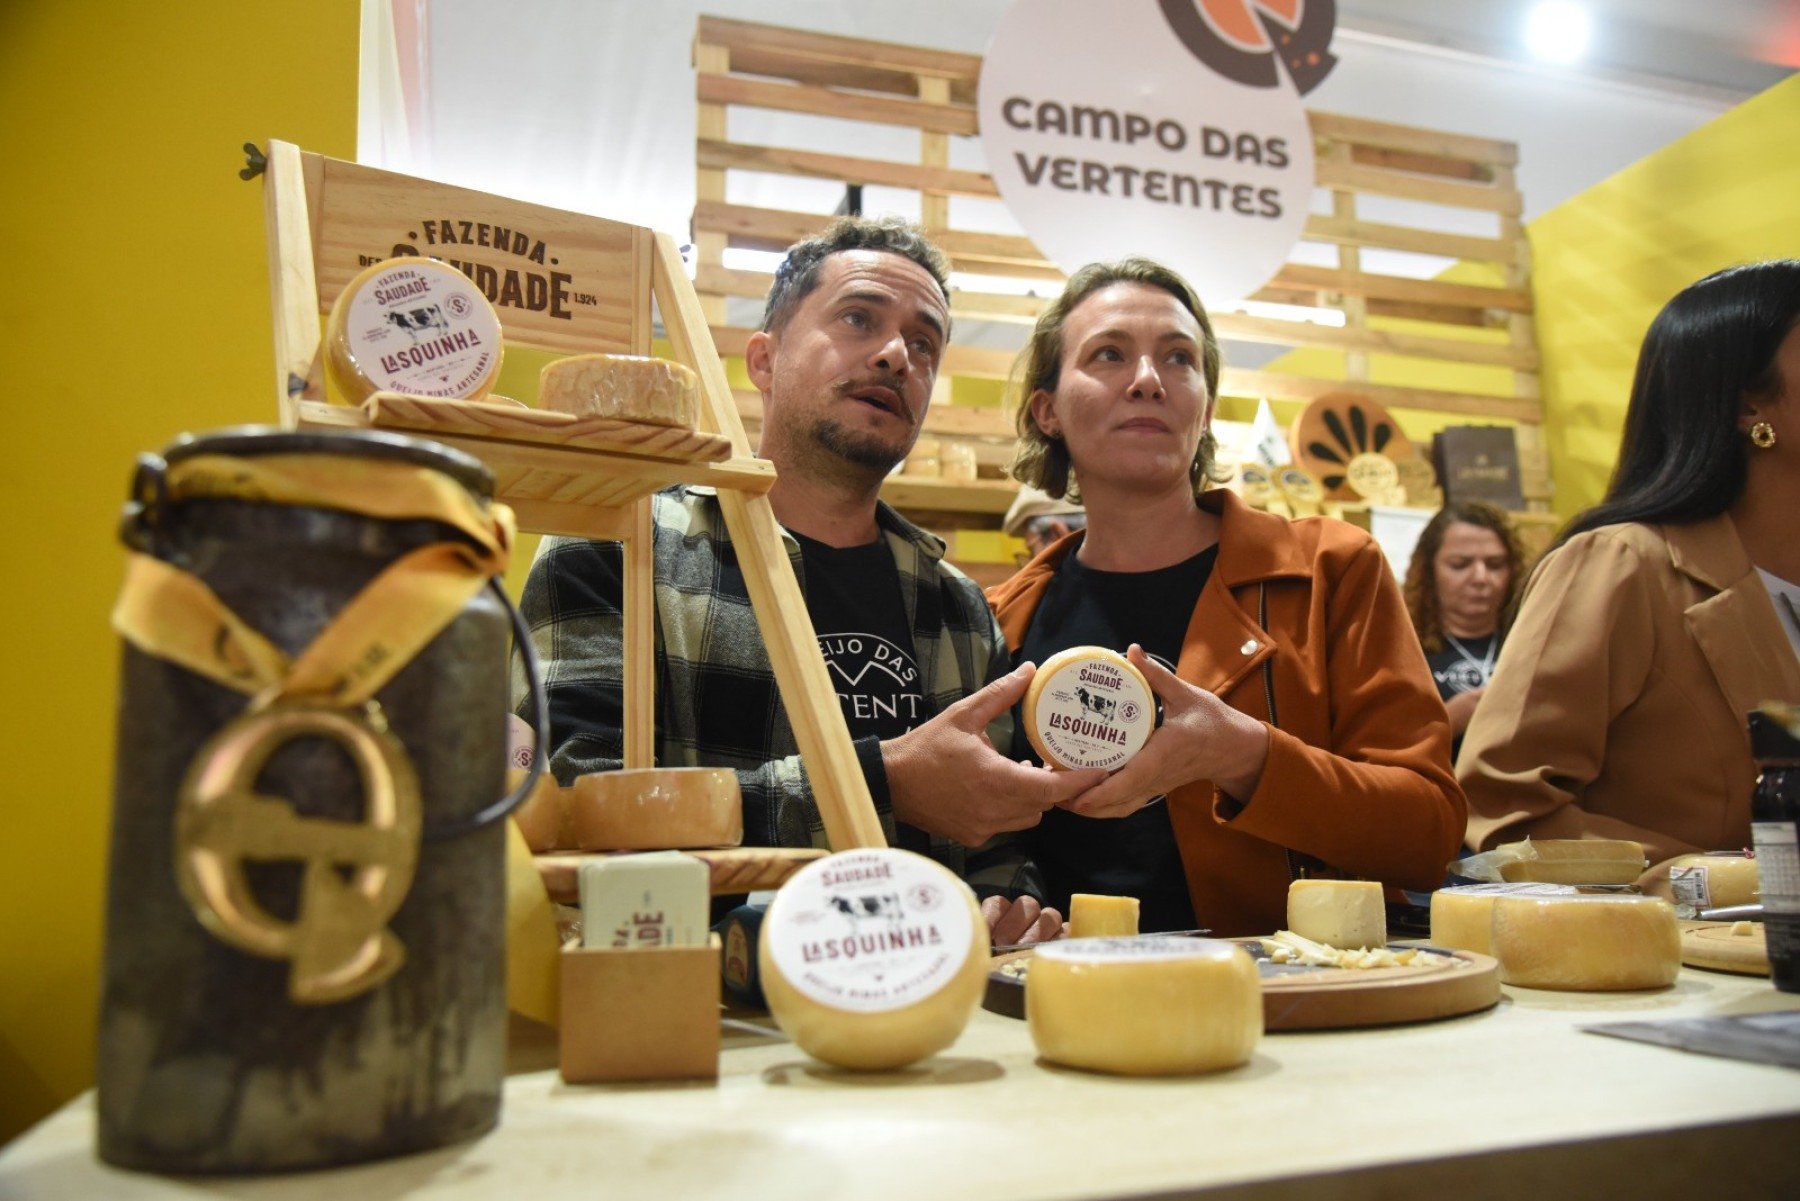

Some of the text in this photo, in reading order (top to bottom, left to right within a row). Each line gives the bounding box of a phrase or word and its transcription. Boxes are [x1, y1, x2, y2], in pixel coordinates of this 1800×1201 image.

[1002, 97, 1290, 169] CAMPO DAS
[1014, 152, 1283, 219] VERTENTES
[422, 219, 547, 266] FAZENDA
[374, 276, 432, 306] SAUDADE
[377, 270, 416, 287] FAZENDA
[380, 328, 482, 375] LASQUINHA
[457, 351, 490, 392] ARTESANAL
[874, 643, 918, 682] DAS
[1079, 668, 1124, 690] SAUDADE
[1089, 663, 1118, 676] FAZENDA
[1049, 712, 1127, 746] LASQUINHA
[1044, 731, 1063, 755] QUEIJO
[1062, 751, 1084, 766] MINAS
[1085, 750, 1126, 768] ARTESANAL
[820, 862, 894, 887] SAUDADE
[801, 925, 943, 964] LASQUINHA
